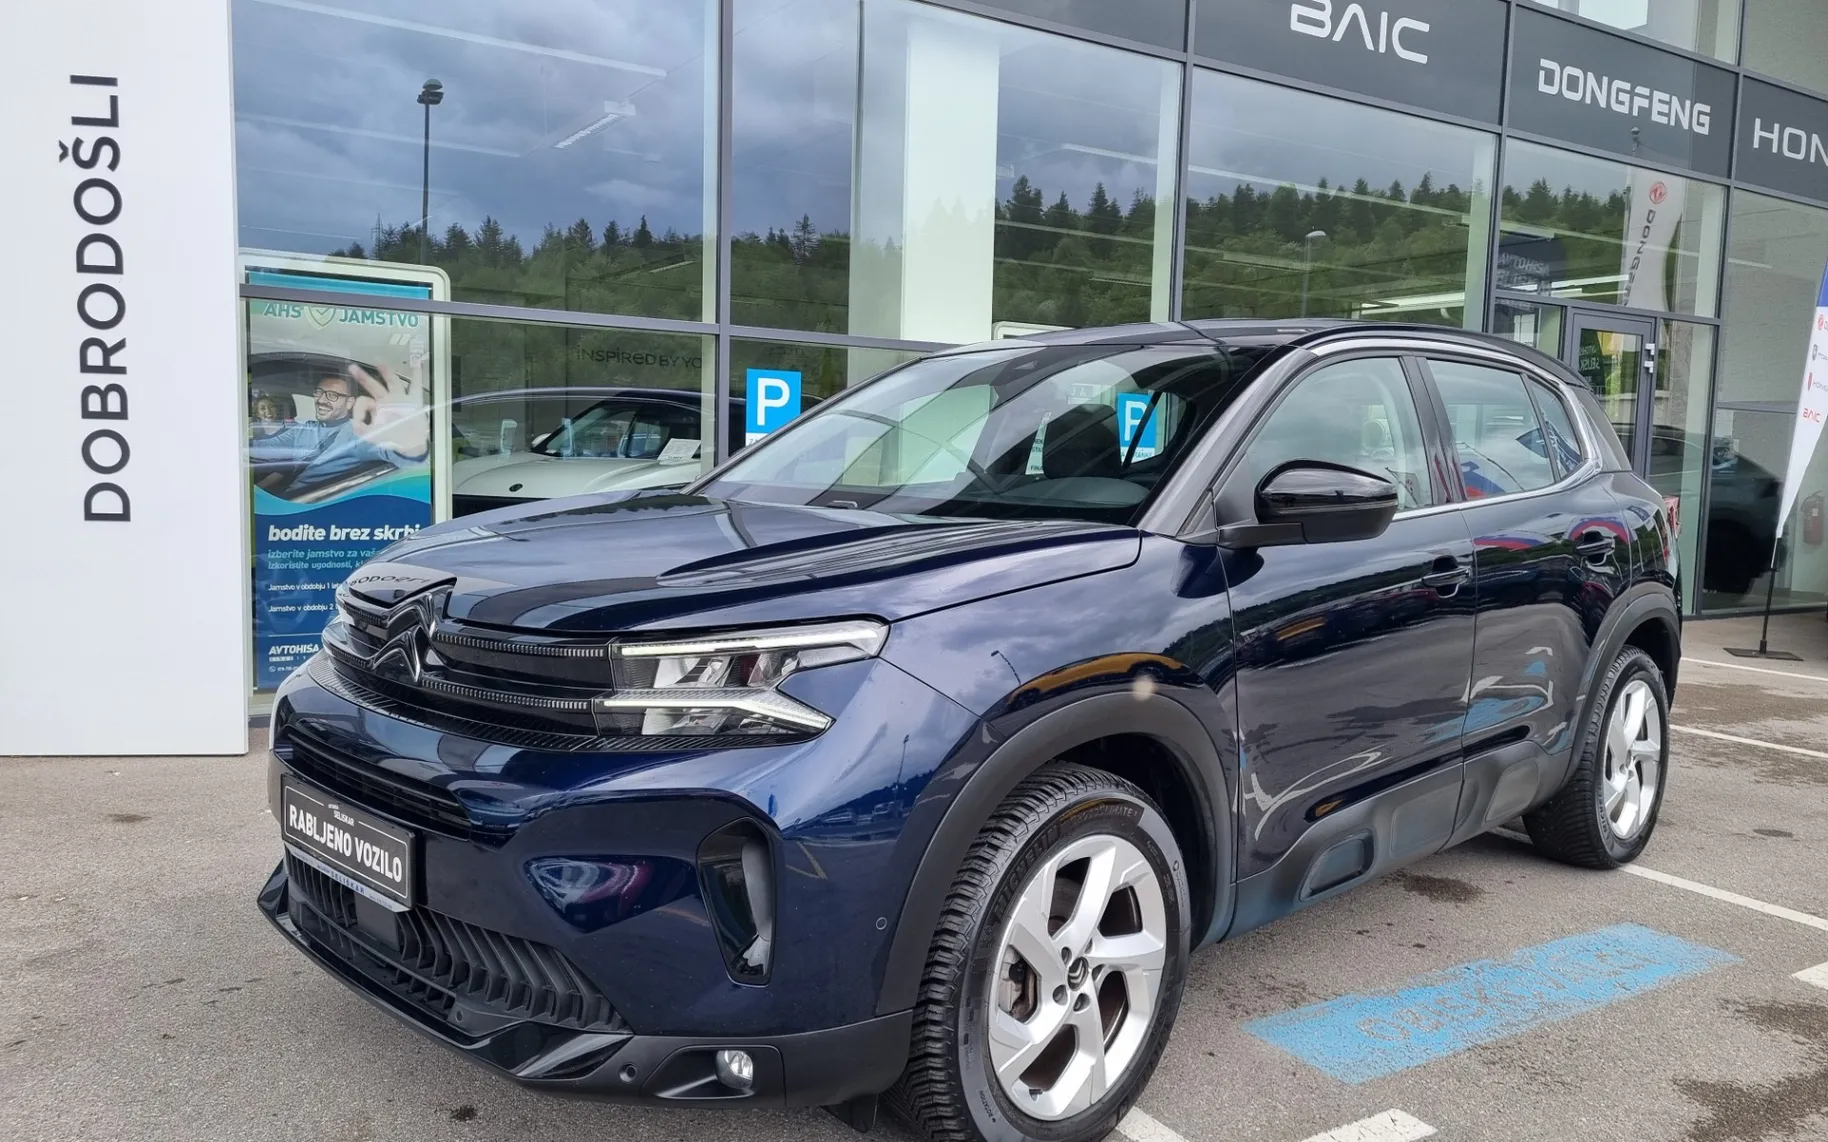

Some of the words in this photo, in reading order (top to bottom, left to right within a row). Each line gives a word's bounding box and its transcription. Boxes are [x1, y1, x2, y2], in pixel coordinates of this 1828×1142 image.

[1290, 0, 1430, 64] BAIC
[1538, 58, 1711, 136] DONGFENG
[59, 74, 131, 522] DOBRODOŠLI
[339, 308, 419, 328] JAMSTVO
[659, 354, 678, 367] BY
[757, 378, 790, 426] P
[268, 525, 326, 541] bodite
[329, 525, 370, 541] brez
[268, 549, 305, 559] izberite
[306, 549, 344, 560] jamstvo
[268, 605, 297, 613] Jamstvo
[289, 804, 352, 857] RABLJENO
[354, 837, 402, 883] VOZILO
